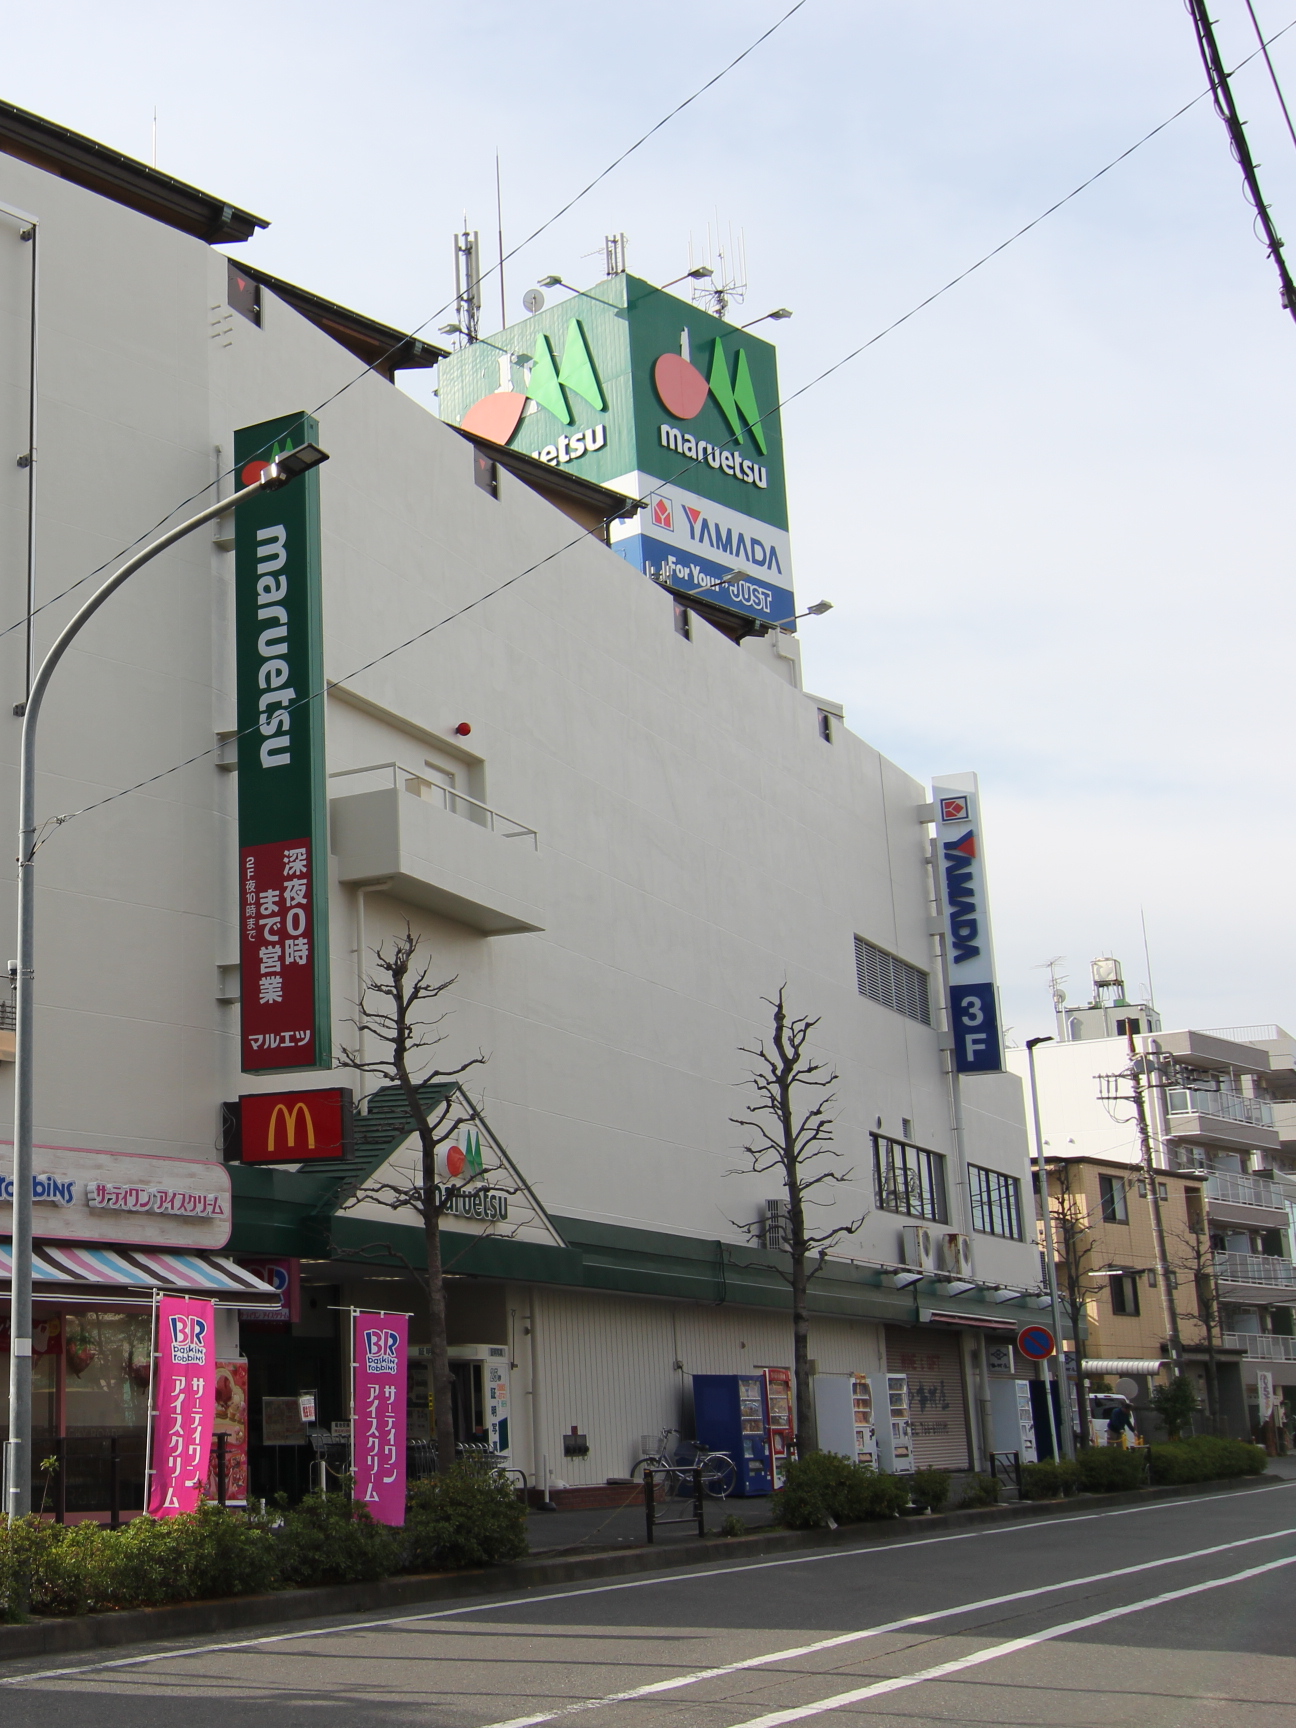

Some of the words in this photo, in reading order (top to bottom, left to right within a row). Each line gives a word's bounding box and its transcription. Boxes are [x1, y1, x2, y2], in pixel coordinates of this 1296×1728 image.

[532, 424, 604, 466] etsu
[660, 424, 767, 489] maruetsu
[668, 555, 690, 580] For
[690, 563, 720, 592] Your
[681, 504, 782, 574] YAMADA
[256, 524, 297, 768] maruetsu
[246, 857, 256, 941] 2F夜10時まで
[283, 848, 308, 965] 深夜0時
[944, 829, 980, 964] YAMADA
[259, 889, 283, 1004] まで営業
[248, 1030, 311, 1049] マルエツ
[96, 1184, 152, 1208] サーティワン
[158, 1191, 224, 1216] アイスクリーム
[174, 1345, 203, 1354] baskin
[174, 1355, 204, 1364] robbins
[368, 1356, 395, 1364] baskin
[368, 1365, 395, 1373] robbins
[163, 1376, 186, 1508] アイスクリーム
[185, 1377, 205, 1486] サーティワン
[364, 1384, 380, 1501] アイスクリーム
[383, 1385, 397, 1483] サーティワン
